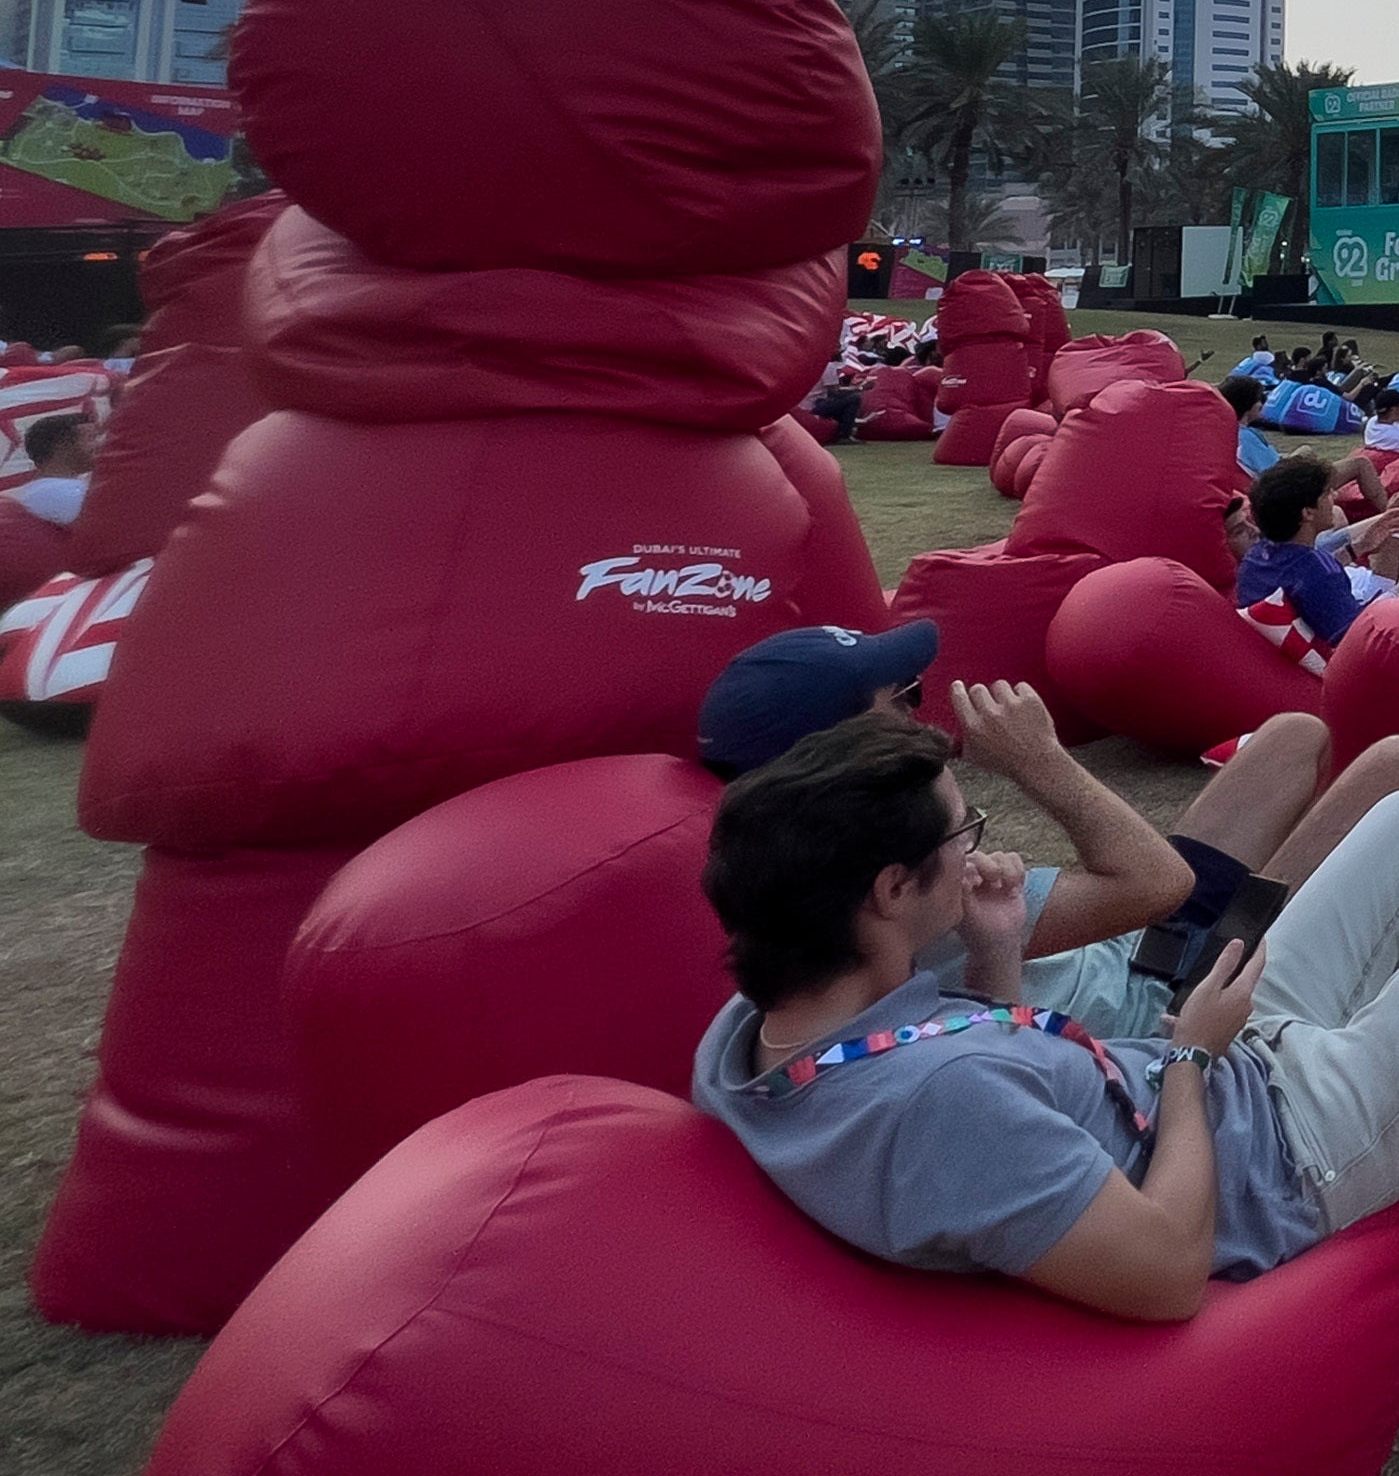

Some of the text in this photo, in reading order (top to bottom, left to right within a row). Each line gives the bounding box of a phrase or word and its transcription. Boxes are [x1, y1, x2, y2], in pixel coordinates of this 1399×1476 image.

[1333, 236, 1368, 277] 92
[633, 544, 741, 559] DUBAI'S ULTIMATE
[576, 557, 772, 603] FanZone
